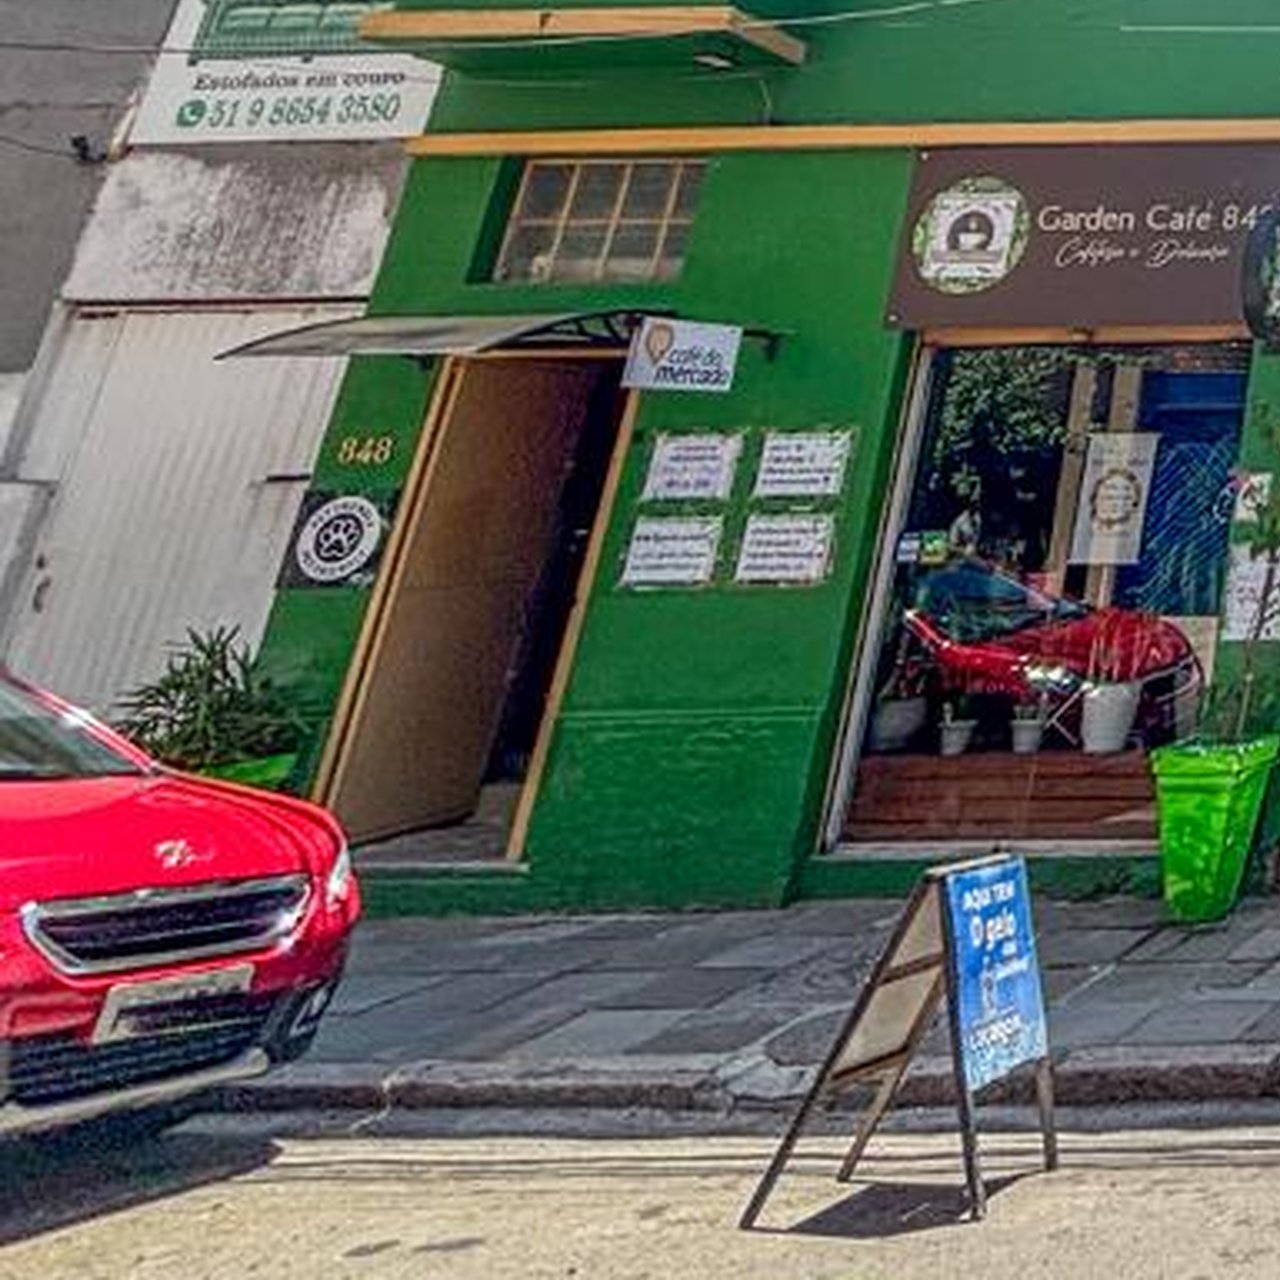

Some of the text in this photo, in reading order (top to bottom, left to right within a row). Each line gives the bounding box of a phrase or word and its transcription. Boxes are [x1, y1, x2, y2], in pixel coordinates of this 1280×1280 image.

[193, 71, 405, 91] Estofados em couro
[1038, 204, 1136, 232] Garden
[1146, 200, 1213, 232] Café
[1221, 204, 1273, 232] 84
[338, 437, 393, 463] 848
